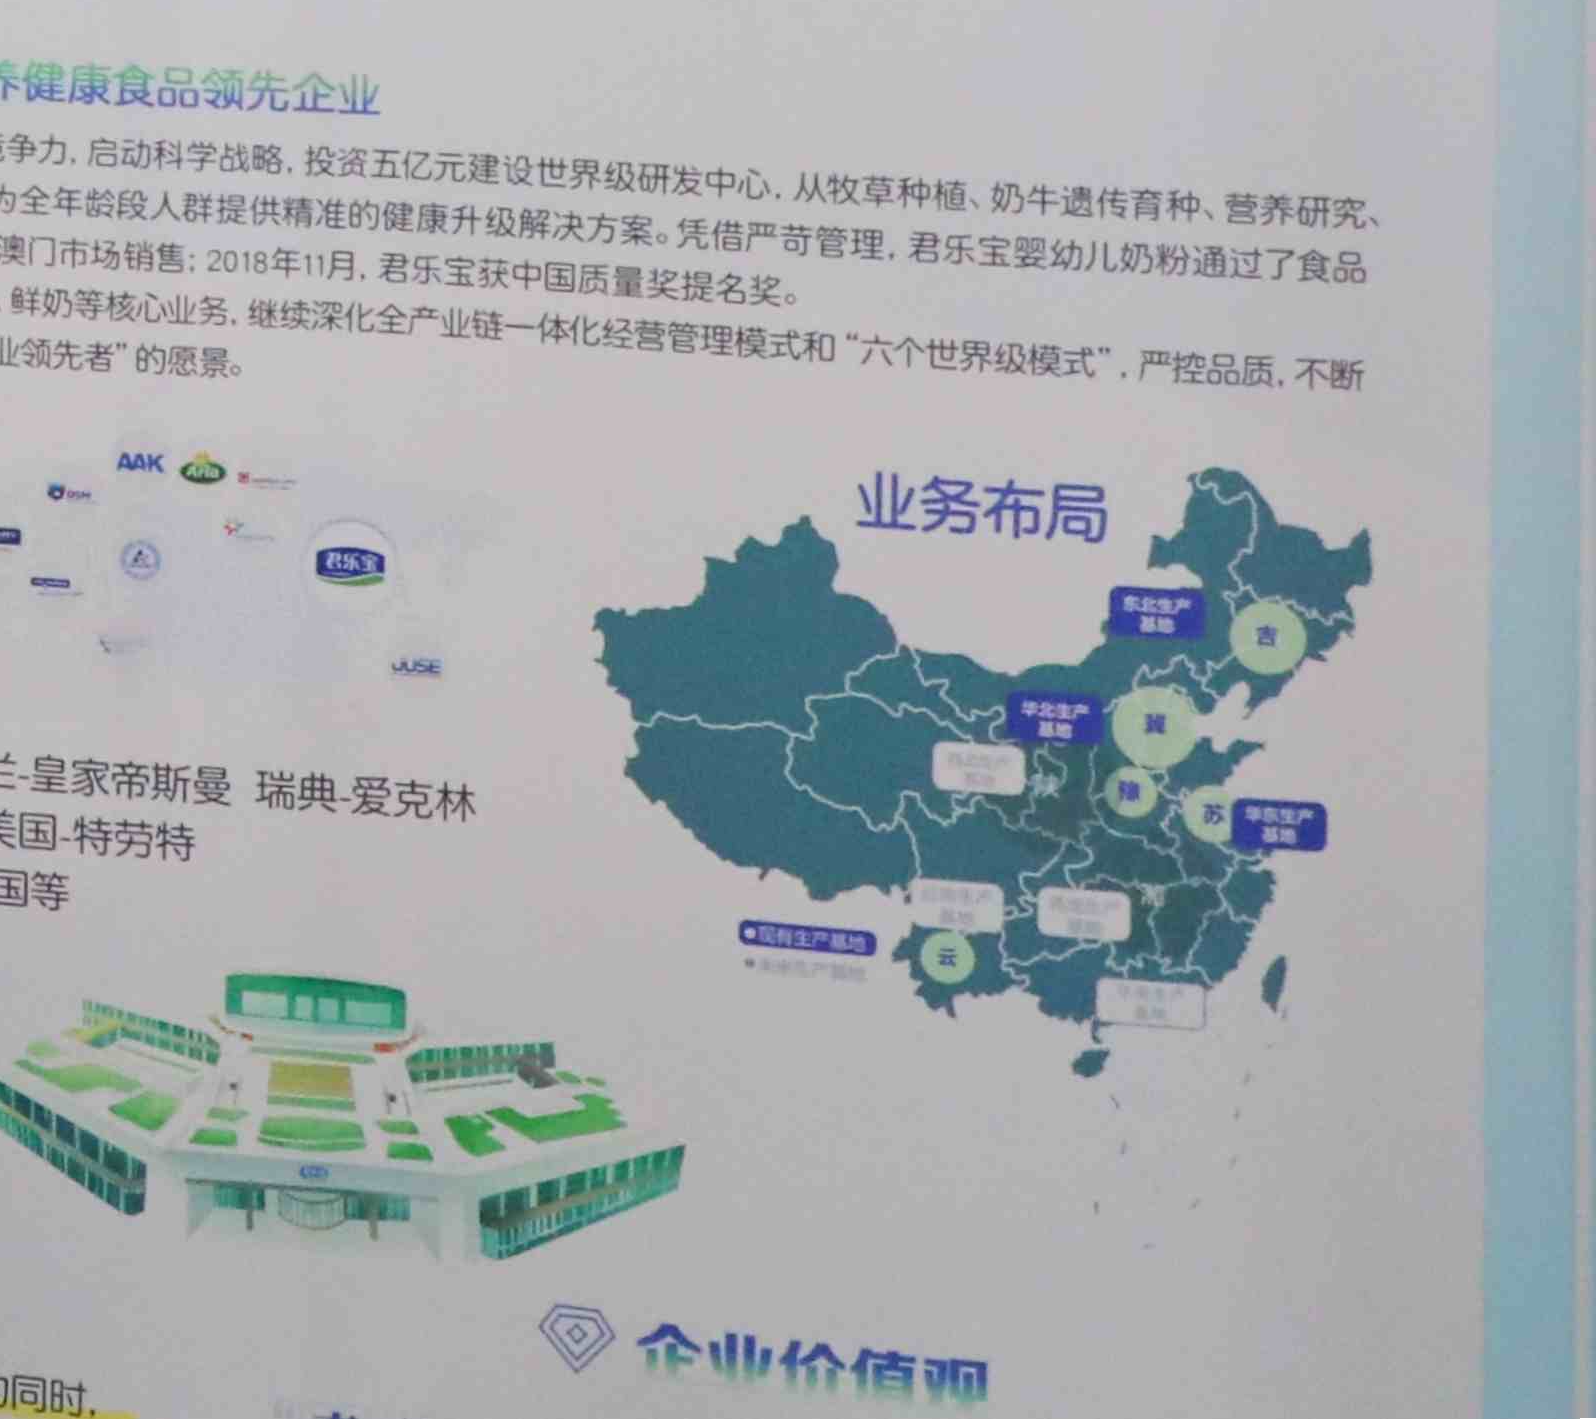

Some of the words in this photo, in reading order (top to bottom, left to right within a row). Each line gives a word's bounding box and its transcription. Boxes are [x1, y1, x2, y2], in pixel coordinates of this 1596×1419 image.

[116, 451, 166, 474] AAK
[855, 470, 1109, 544] 业务布局
[1255, 625, 1278, 647] 吉
[255, 768, 477, 824] 瑞典-爱克林
[1203, 803, 1225, 826] 苏
[938, 947, 957, 967] 云
